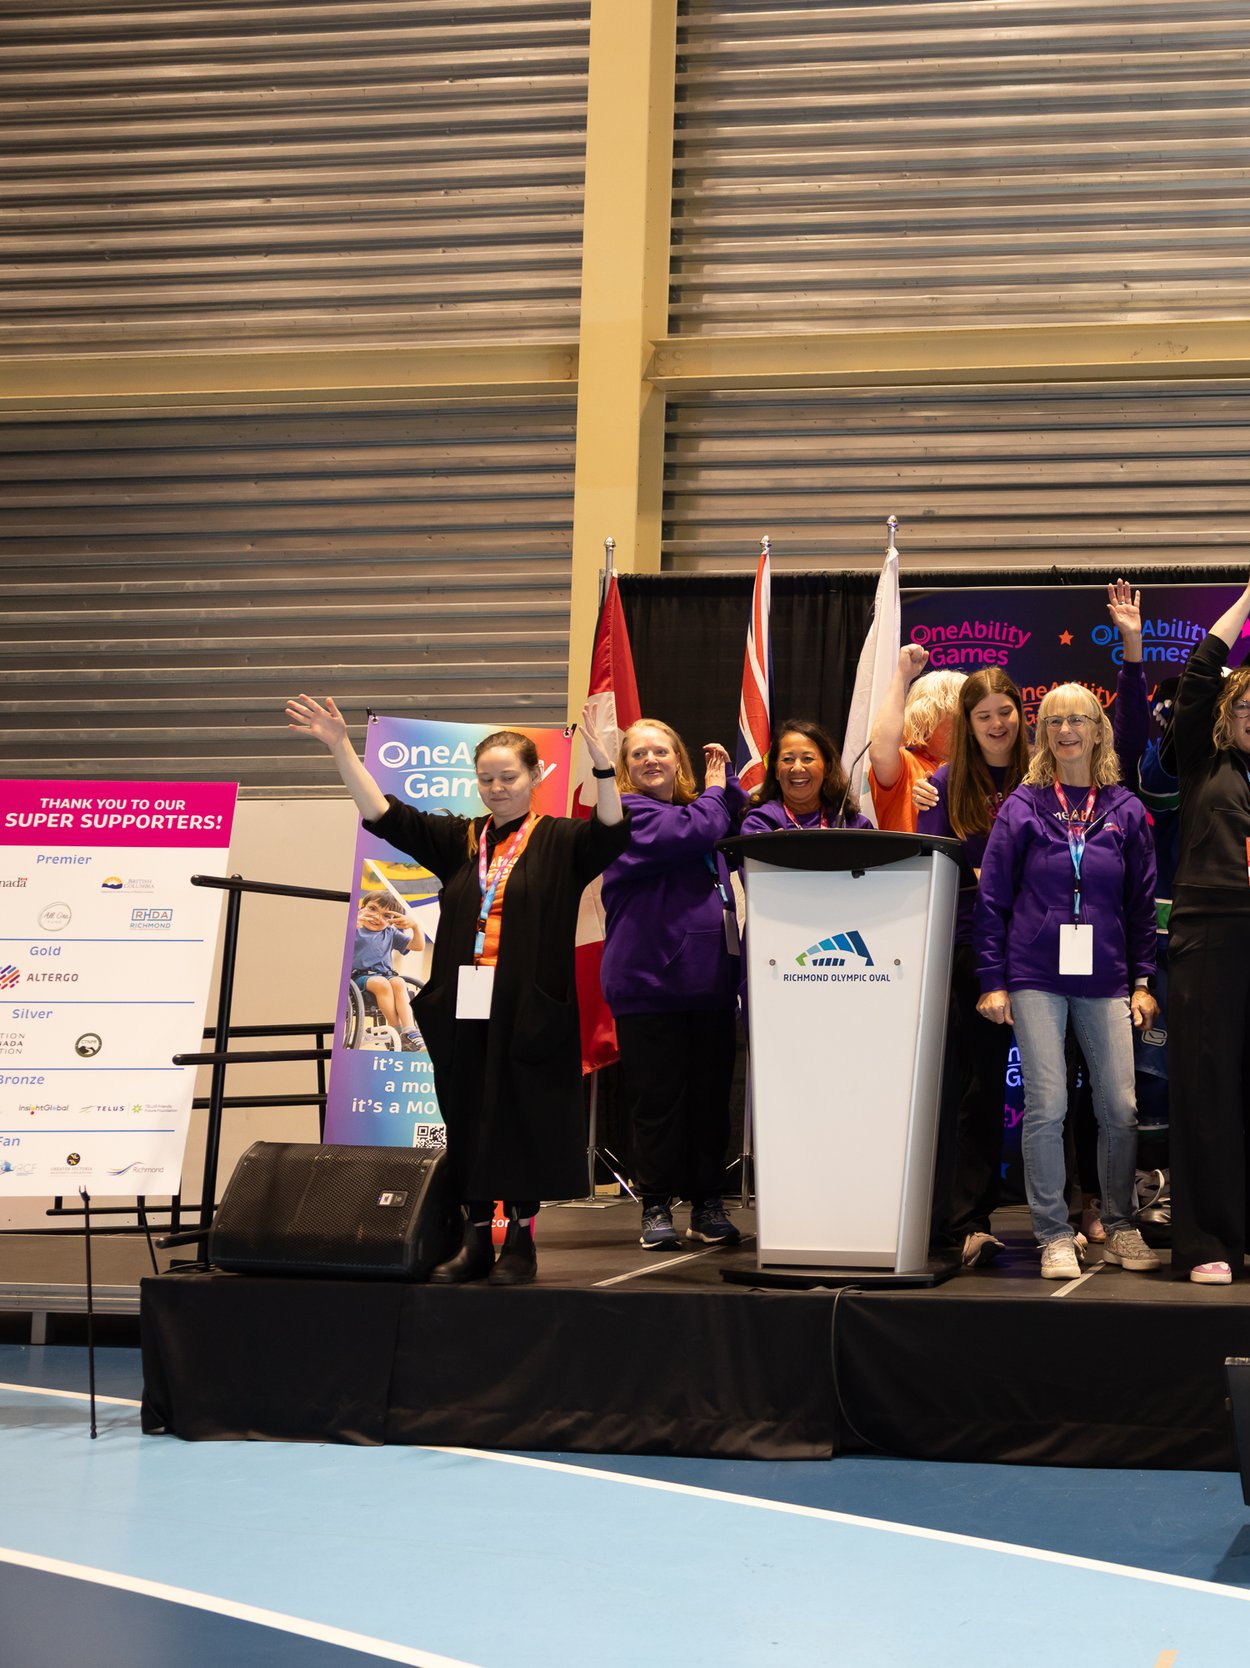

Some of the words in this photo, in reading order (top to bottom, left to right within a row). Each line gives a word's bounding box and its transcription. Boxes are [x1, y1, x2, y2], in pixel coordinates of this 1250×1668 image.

[910, 620, 1031, 649] OneAbility
[1091, 618, 1207, 645] OAbilit
[930, 647, 1009, 666] Games
[1111, 646, 1190, 665] Gmes
[404, 774, 480, 798] Gam
[40, 798, 92, 809] THANK
[97, 799, 126, 810] YOU
[131, 799, 149, 810] TO
[154, 800, 185, 811] OUR
[5, 813, 74, 828] SUPER
[80, 814, 222, 830] SUPPORTERS!
[37, 854, 92, 865] Premier
[0, 877, 27, 887] nada
[30, 946, 61, 956] Gold
[27, 973, 79, 982] ALTERGO
[783, 974, 828, 982] RICHMOND
[831, 974, 867, 982] OLYMPIC
[869, 974, 890, 982] OVAL
[12, 1009, 53, 1019] Silver
[384, 1080, 395, 1093] a
[389, 1101, 400, 1113] a
[406, 1101, 437, 1115] MO
